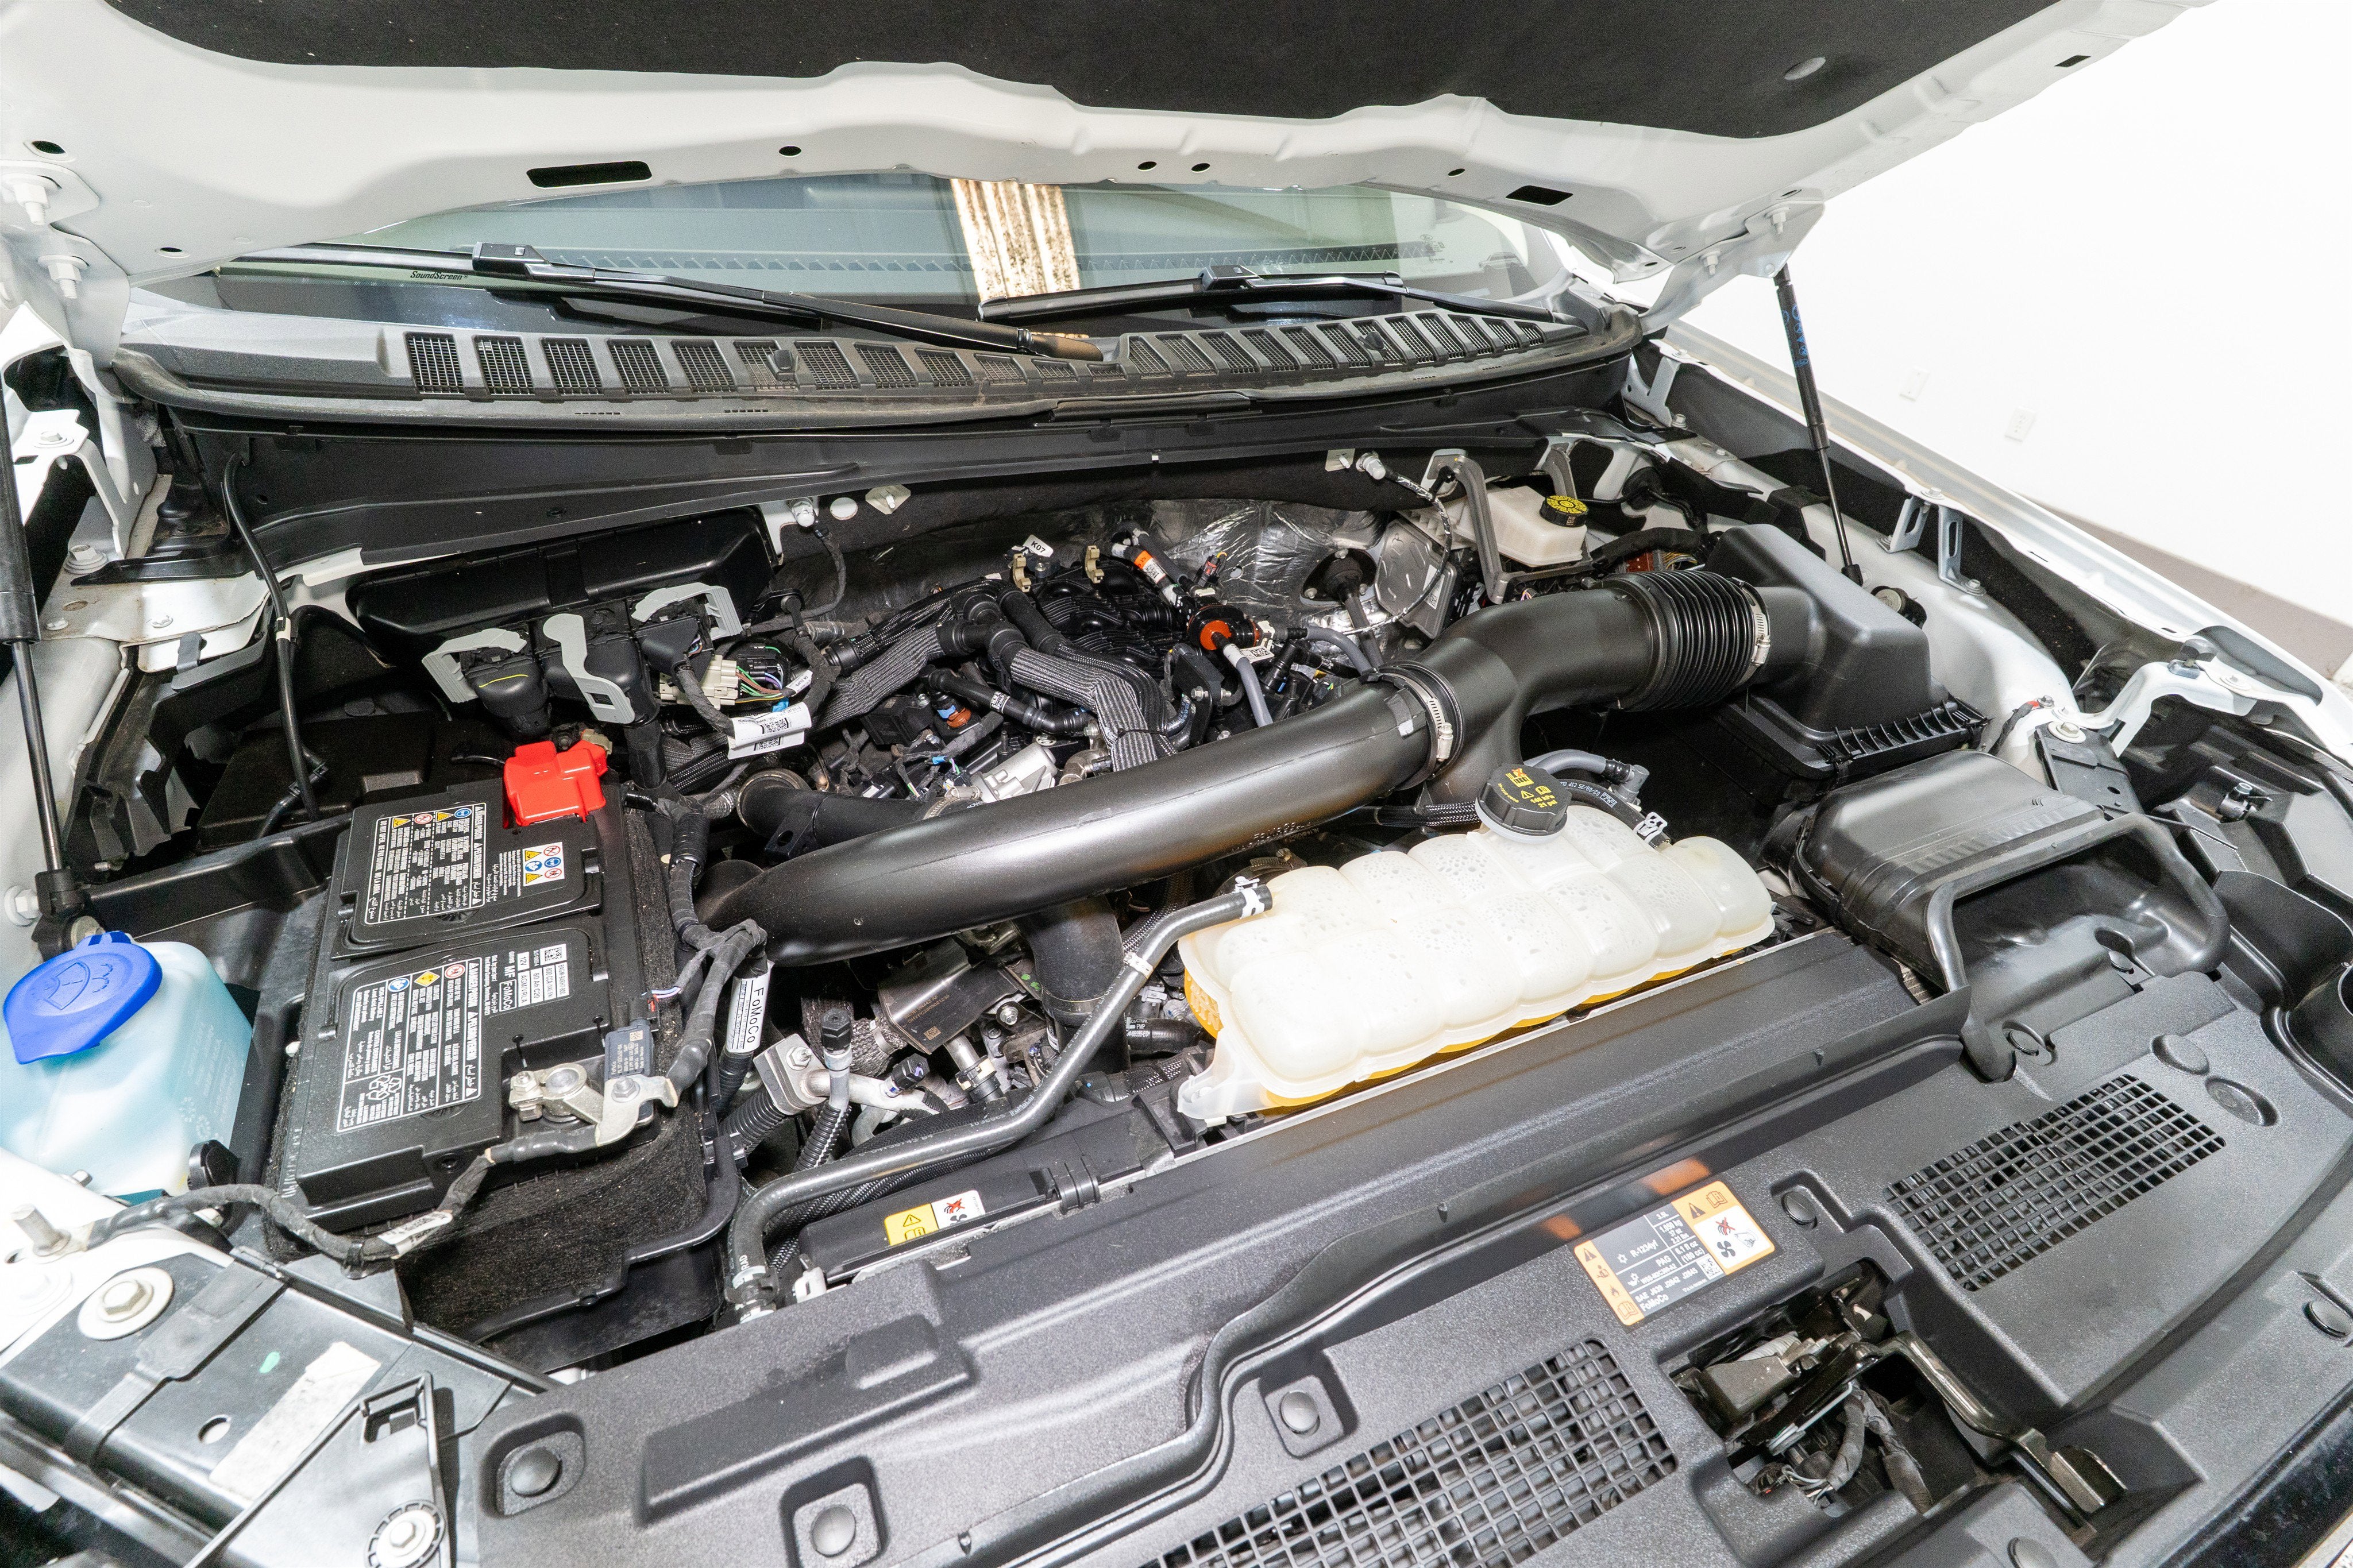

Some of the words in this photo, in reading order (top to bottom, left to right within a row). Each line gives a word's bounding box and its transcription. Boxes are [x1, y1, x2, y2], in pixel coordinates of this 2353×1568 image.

[1031, 541, 1046, 553] K07
[1578, 785, 1600, 797] 02/08/25
[504, 965, 515, 978] MF
[503, 982, 513, 1010] FoMoCo
[747, 987, 764, 1044] FoMoCo
[466, 1018, 477, 1060] PELIGRO/VENENO
[1675, 1246, 1685, 1255] 6.1
[1694, 1247, 1706, 1256] cc)
[739, 1254, 750, 1271] RAD
[1656, 1255, 1672, 1267] PAG
[1635, 1292, 1649, 1303] SAE
[1640, 1294, 1669, 1311] FoMoCo
